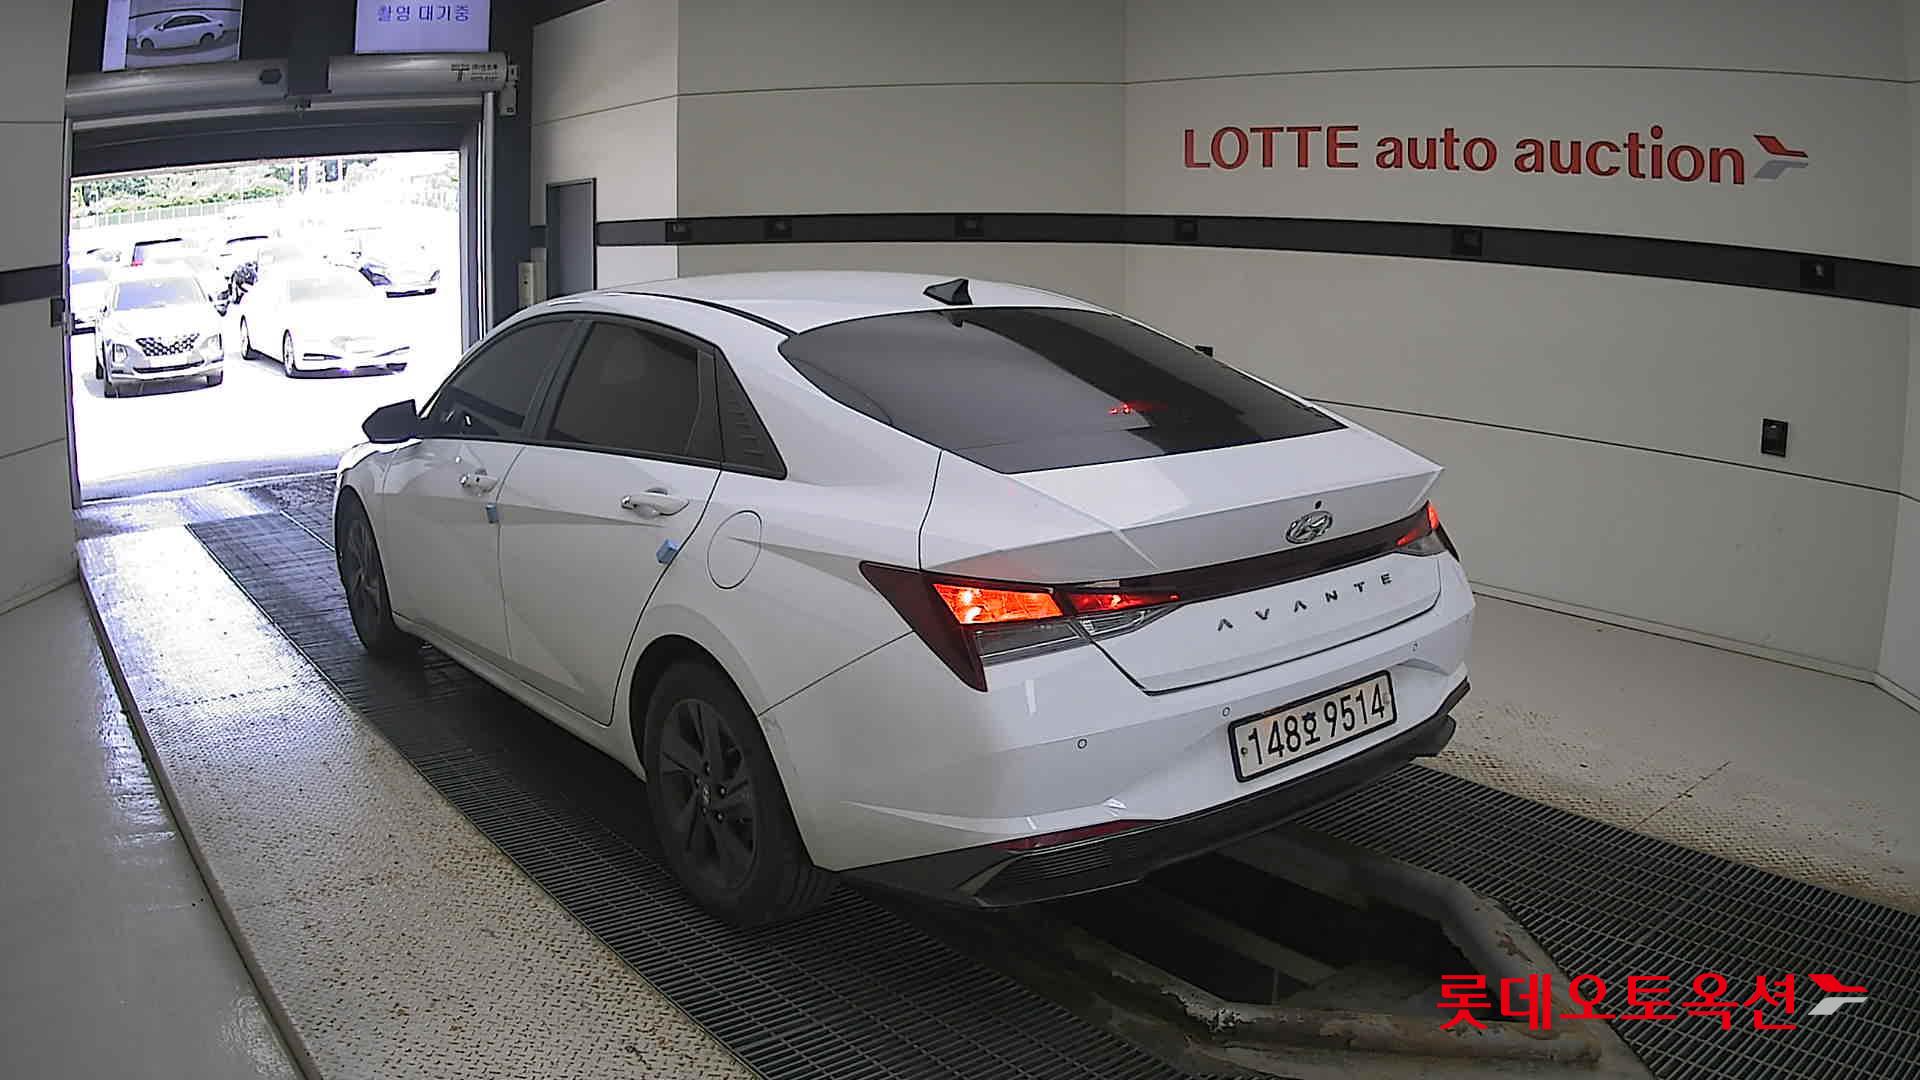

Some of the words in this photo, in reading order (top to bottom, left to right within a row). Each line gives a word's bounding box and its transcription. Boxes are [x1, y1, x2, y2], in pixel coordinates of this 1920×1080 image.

[419, 5, 469, 21] 대기중
[1183, 126, 1360, 169] LOTTE
[1375, 127, 1498, 171] auto
[1514, 125, 1745, 185] auction
[1217, 573, 1393, 631] AVANTE
